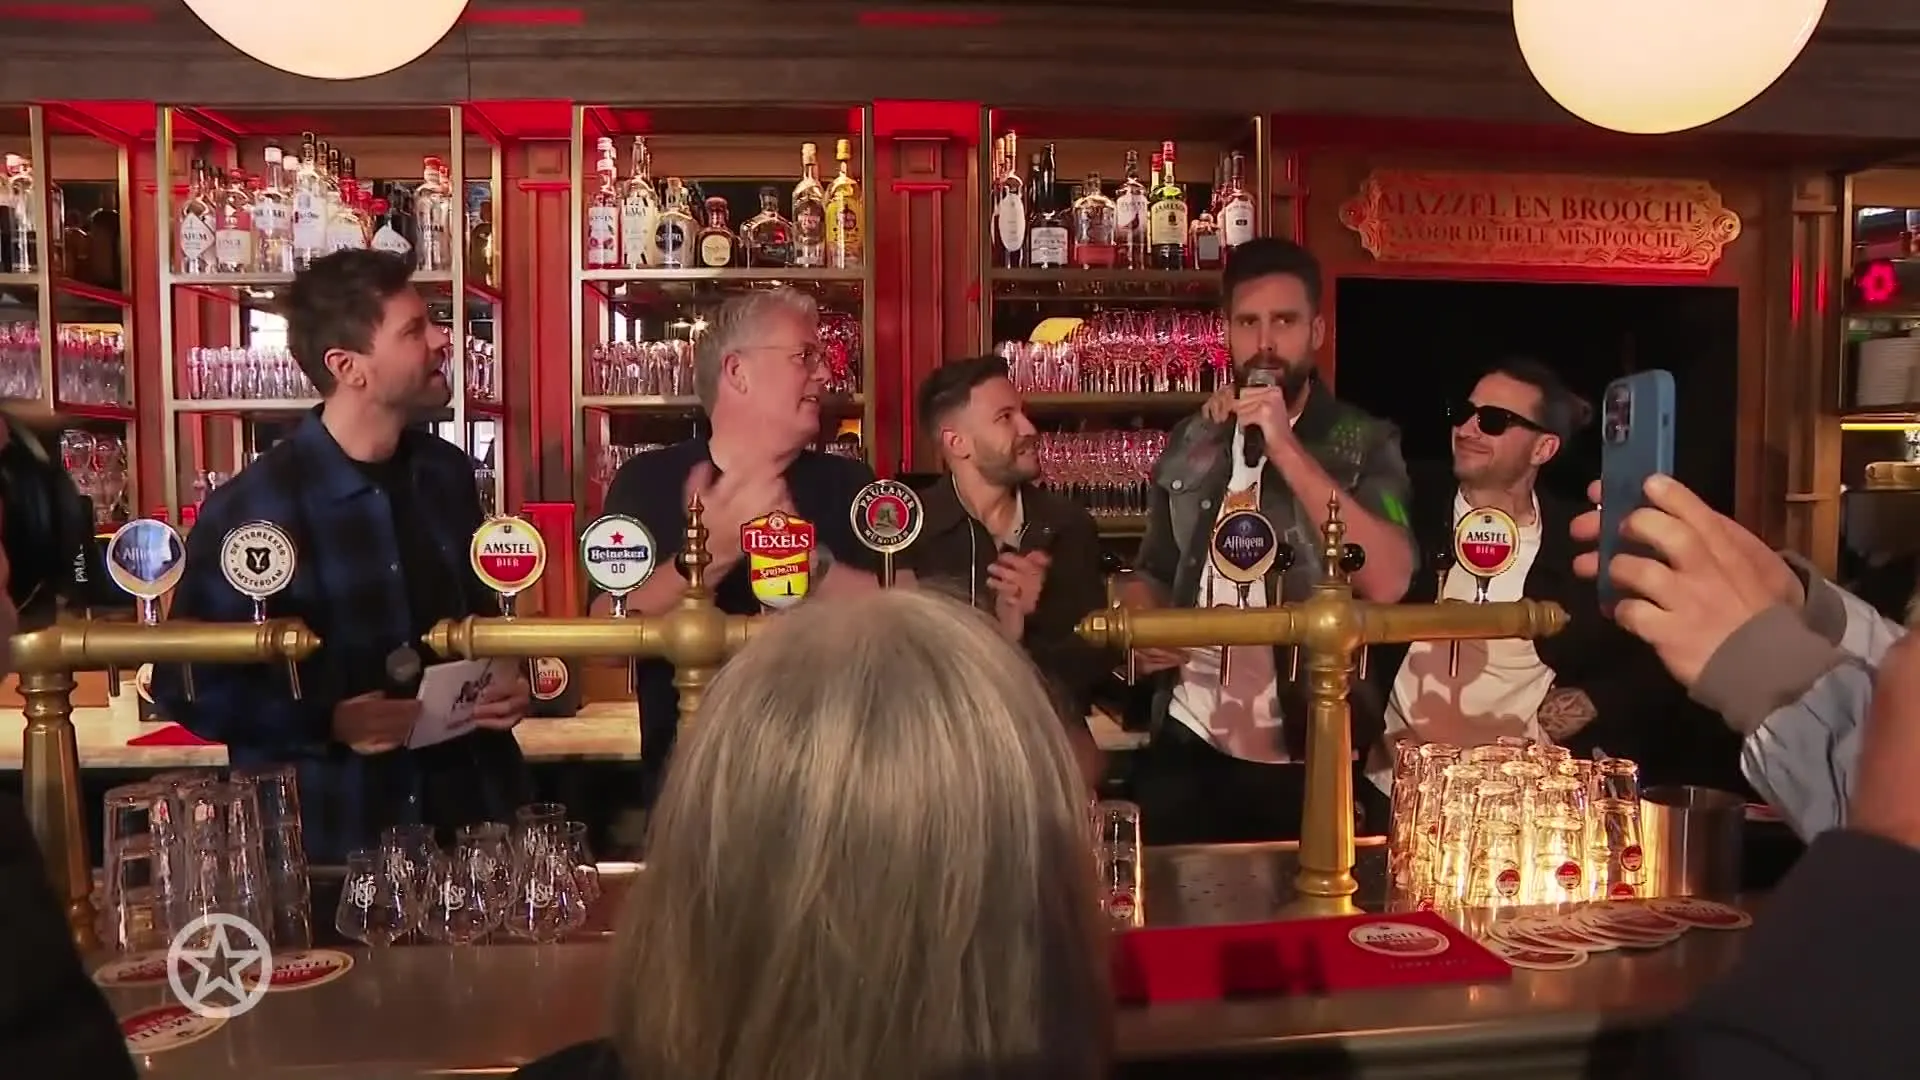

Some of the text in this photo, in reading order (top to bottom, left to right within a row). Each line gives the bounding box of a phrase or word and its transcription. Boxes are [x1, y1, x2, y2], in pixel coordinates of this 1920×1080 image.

[1515, 194, 1551, 218] EN
[1561, 197, 1697, 223] BROOCHE
[860, 485, 915, 510] PAULANER
[745, 530, 810, 549] TEXELS
[1223, 535, 1264, 551] Affligem
[1466, 531, 1508, 543] AMSTEL
[483, 543, 533, 554] AMSTEL
[591, 549, 646, 560] Heineken
[1476, 545, 1496, 555] BIER
[496, 558, 519, 567] BIER
